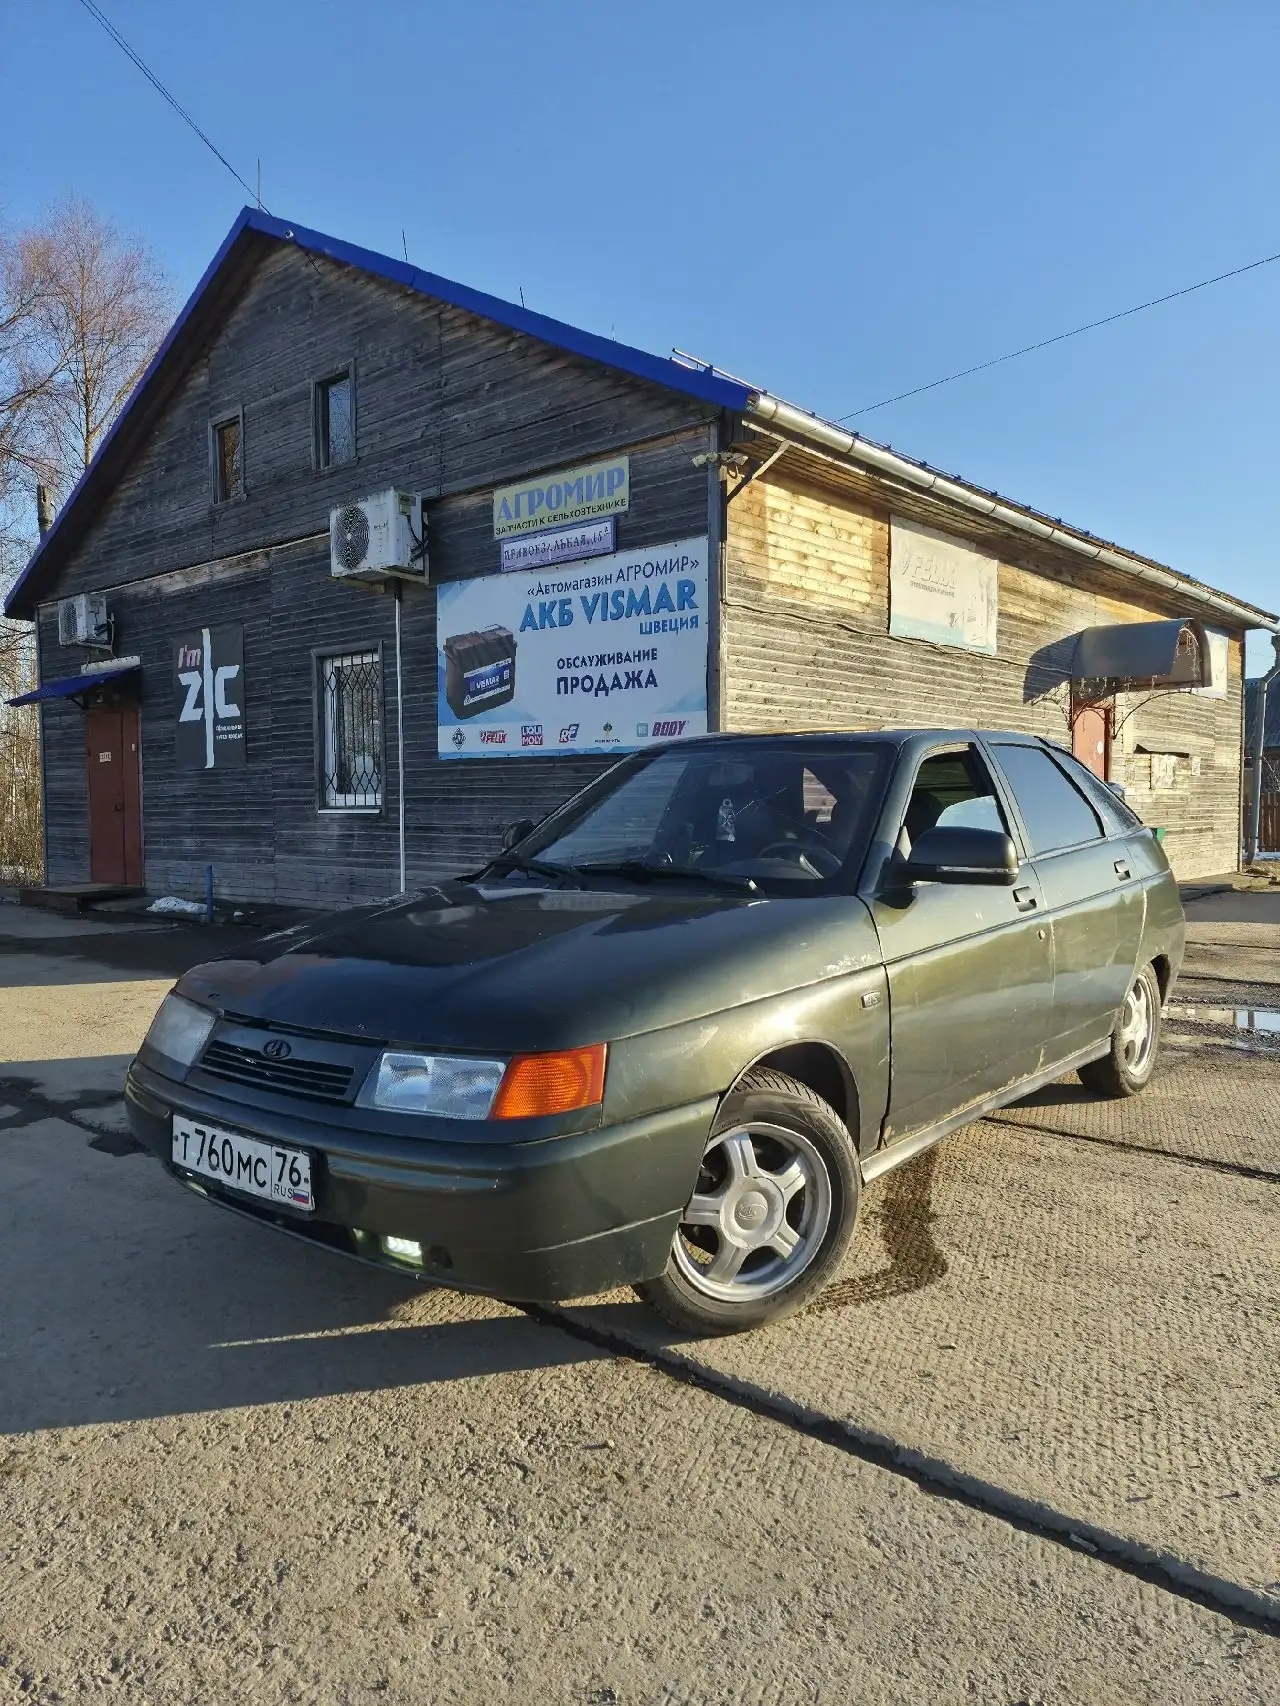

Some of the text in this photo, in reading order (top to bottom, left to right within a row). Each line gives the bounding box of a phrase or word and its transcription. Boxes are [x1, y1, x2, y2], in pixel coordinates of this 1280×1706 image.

[497, 466, 625, 522] АГРОМИР
[495, 498, 627, 535] ЗАПЧАСТИ К СЕЛЬХОЗТЕХНИКЕ
[527, 555, 700, 597] «Автомагазин АГРОМИР»
[519, 578, 699, 632] АКБ VISMAR
[639, 615, 699, 636] ШВЕЦИЯ
[178, 644, 201, 669] I'm
[556, 647, 658, 670] ОБСЛУЖИВАНИЕ
[556, 668, 659, 697] ПРОДАЖА
[521, 735, 543, 746] MOLY
[652, 720, 686, 737] BODY
[275, 1151, 302, 1187] 76
[273, 1183, 294, 1199] RUS
